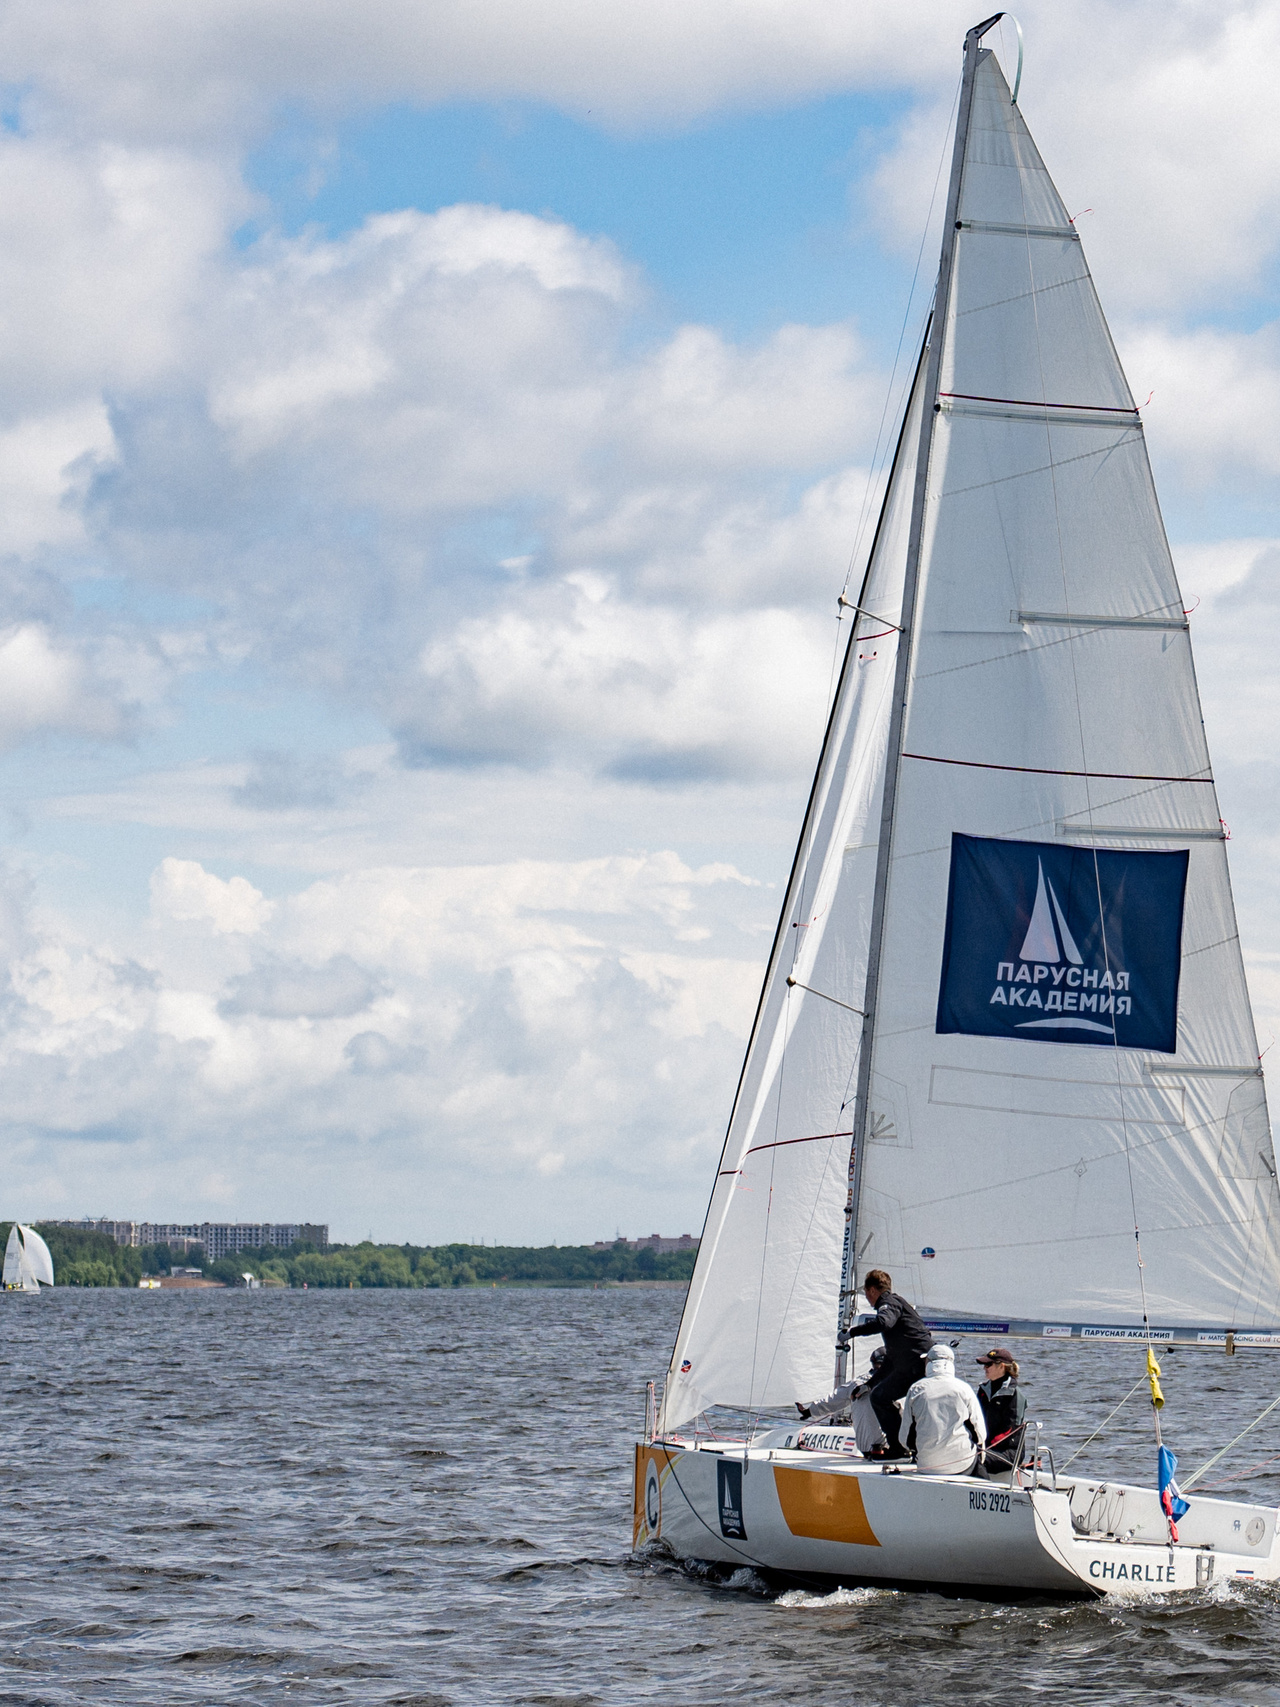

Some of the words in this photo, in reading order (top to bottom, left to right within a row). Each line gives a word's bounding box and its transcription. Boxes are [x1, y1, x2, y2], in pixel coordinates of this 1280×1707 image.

[996, 961, 1130, 991] ПАРУСНАЯ
[989, 986, 1132, 1015] АКАДЕМИЯ
[845, 1188, 853, 1222] CUB
[841, 1227, 850, 1279] RACING
[1085, 1329, 1125, 1337] ПАРУСНАЯ
[1127, 1331, 1170, 1339] АКАДЕМИЯ
[647, 1476, 658, 1529] C
[968, 1491, 987, 1511] RUS
[989, 1494, 1011, 1513] 2922
[1089, 1559, 1176, 1583] CHARLIE
